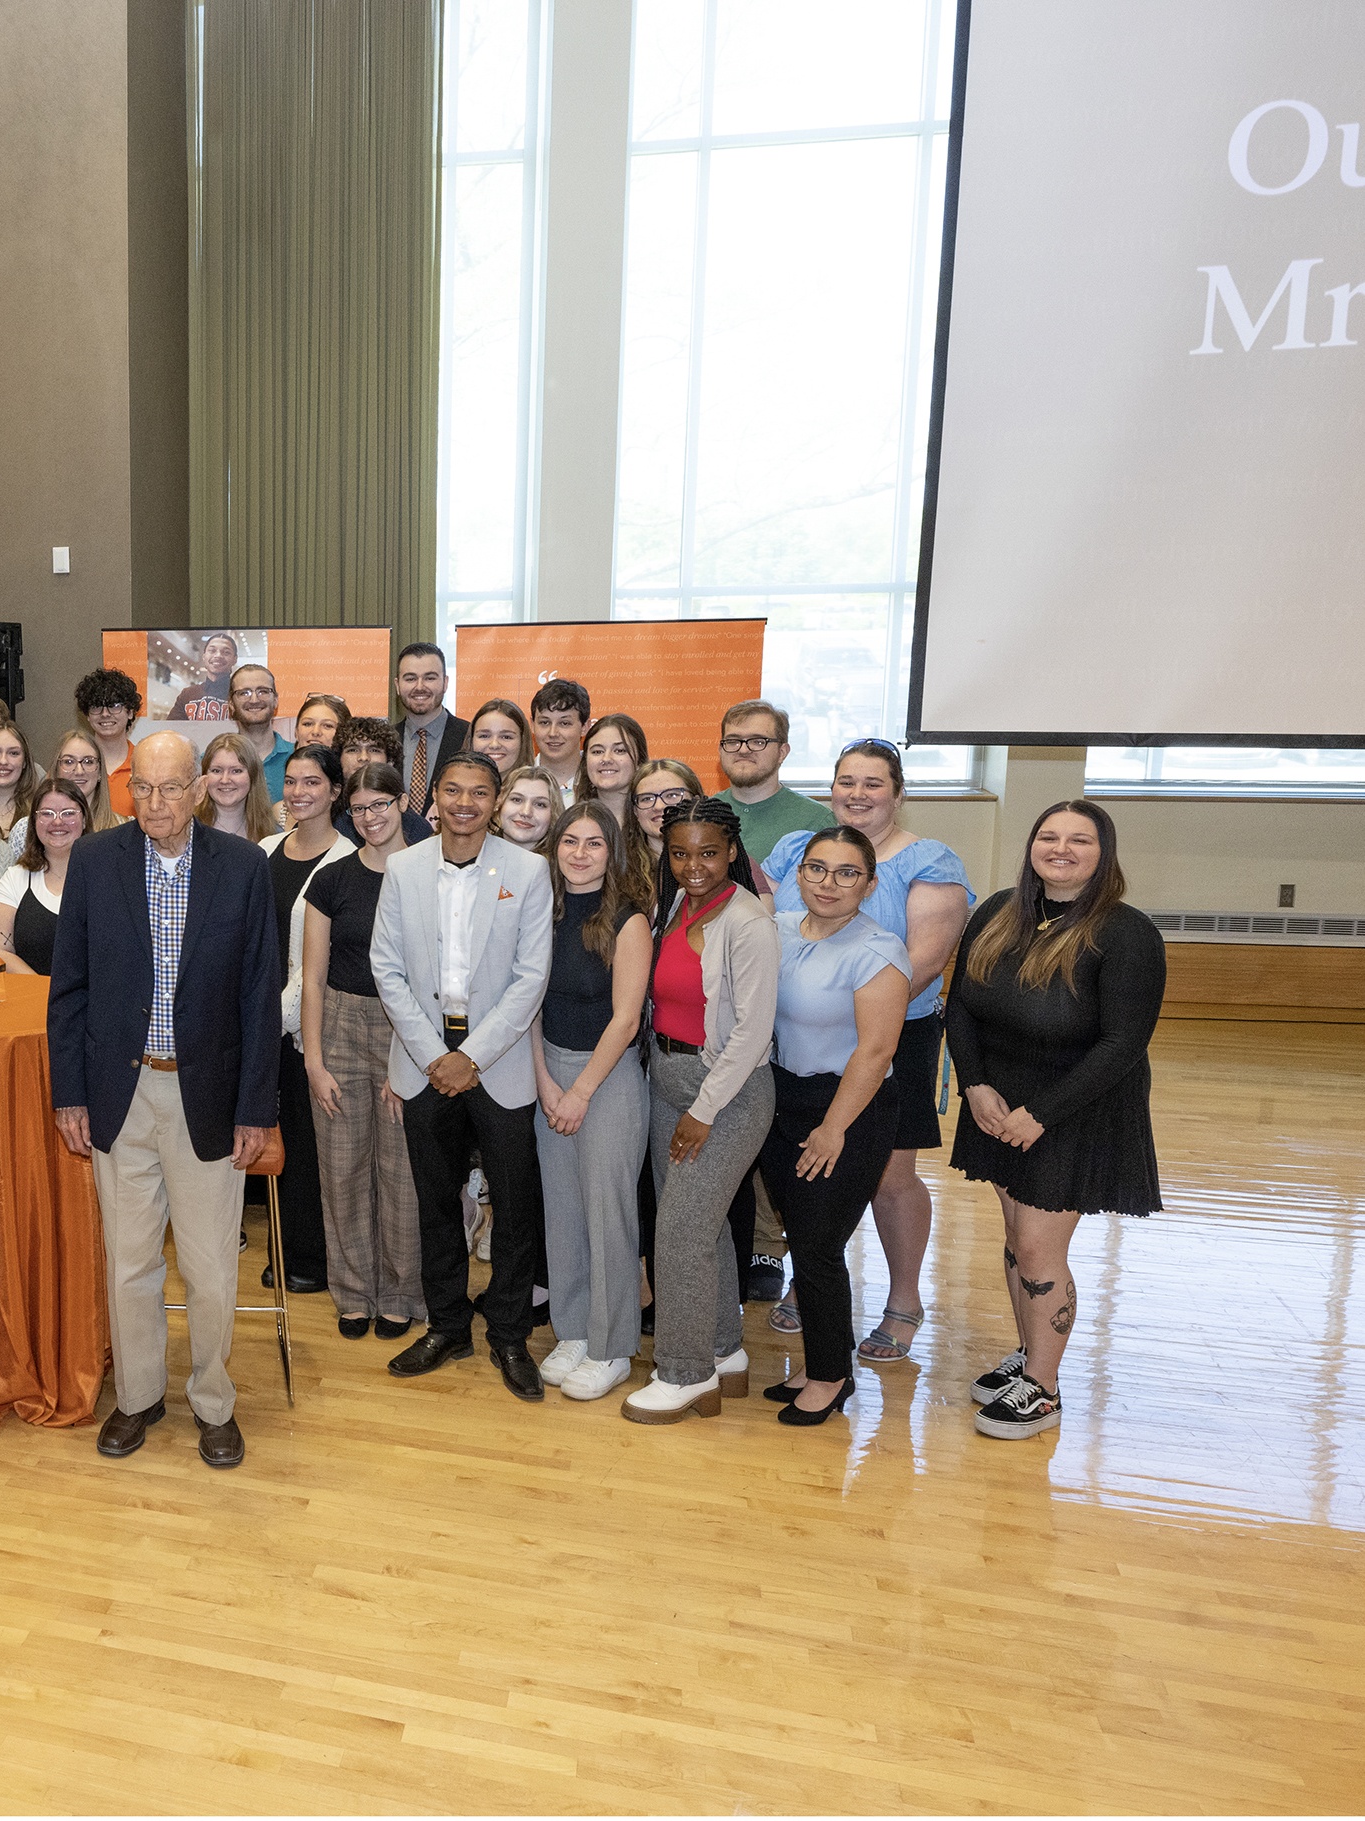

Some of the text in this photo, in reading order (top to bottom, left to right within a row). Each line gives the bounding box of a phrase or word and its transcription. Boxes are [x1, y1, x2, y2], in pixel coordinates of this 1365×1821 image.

[662, 633, 686, 642] bigger
[664, 653, 680, 661] stay
[682, 651, 714, 659] enrolled
[733, 651, 745, 659] get
[747, 651, 759, 659] my
[295, 658, 310, 666] stay
[312, 657, 342, 665] enrolled
[361, 658, 372, 666] get
[374, 658, 385, 666] my
[609, 670, 632, 678] giving
[706, 668, 726, 677] being
[335, 674, 354, 682] being
[603, 687, 633, 696] passion
[635, 687, 651, 695] and
[653, 686, 668, 694] love
[670, 686, 683, 695] for
[702, 703, 717, 711] truly
[668, 721, 687, 729] years
